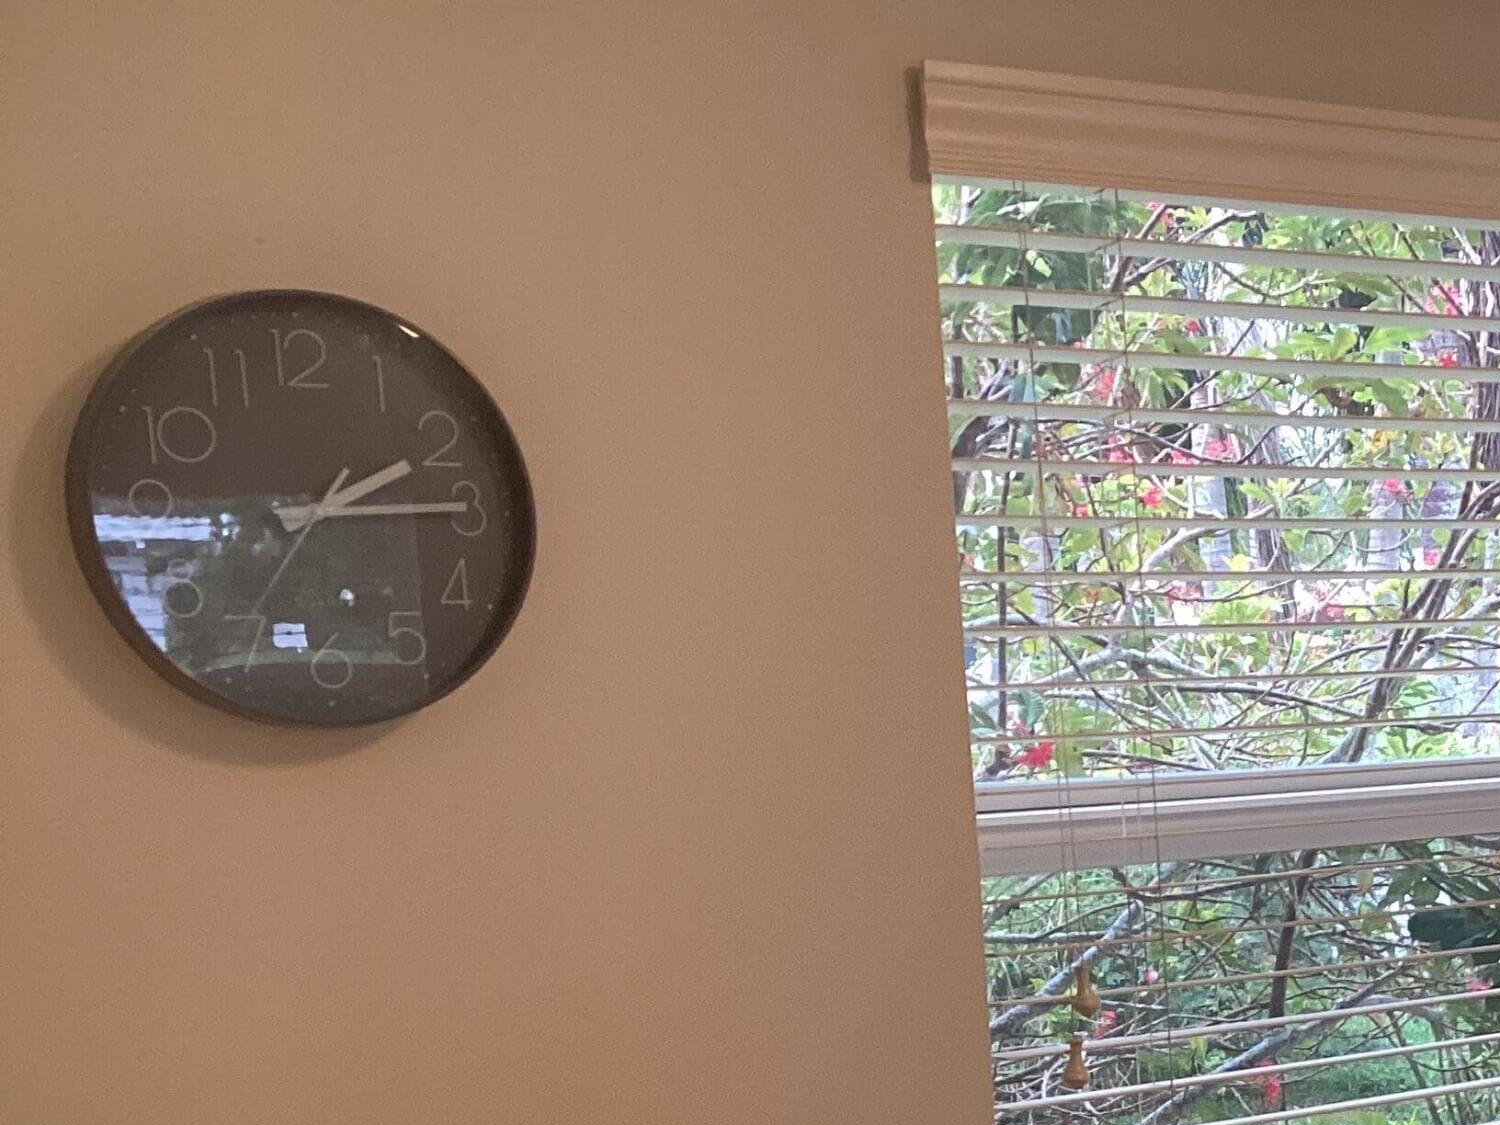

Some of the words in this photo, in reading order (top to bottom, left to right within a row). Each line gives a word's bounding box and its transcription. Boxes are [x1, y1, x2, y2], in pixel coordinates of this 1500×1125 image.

[202, 347, 249, 408] 11
[271, 328, 329, 388] 12
[371, 354, 387, 412] 1
[141, 405, 217, 464] 10
[418, 410, 463, 467] 2
[449, 480, 488, 537] 3
[163, 557, 203, 618] 8
[440, 558, 472, 611] 4
[224, 614, 266, 673] 7
[310, 632, 353, 689] 6
[387, 611, 427, 666] 5
